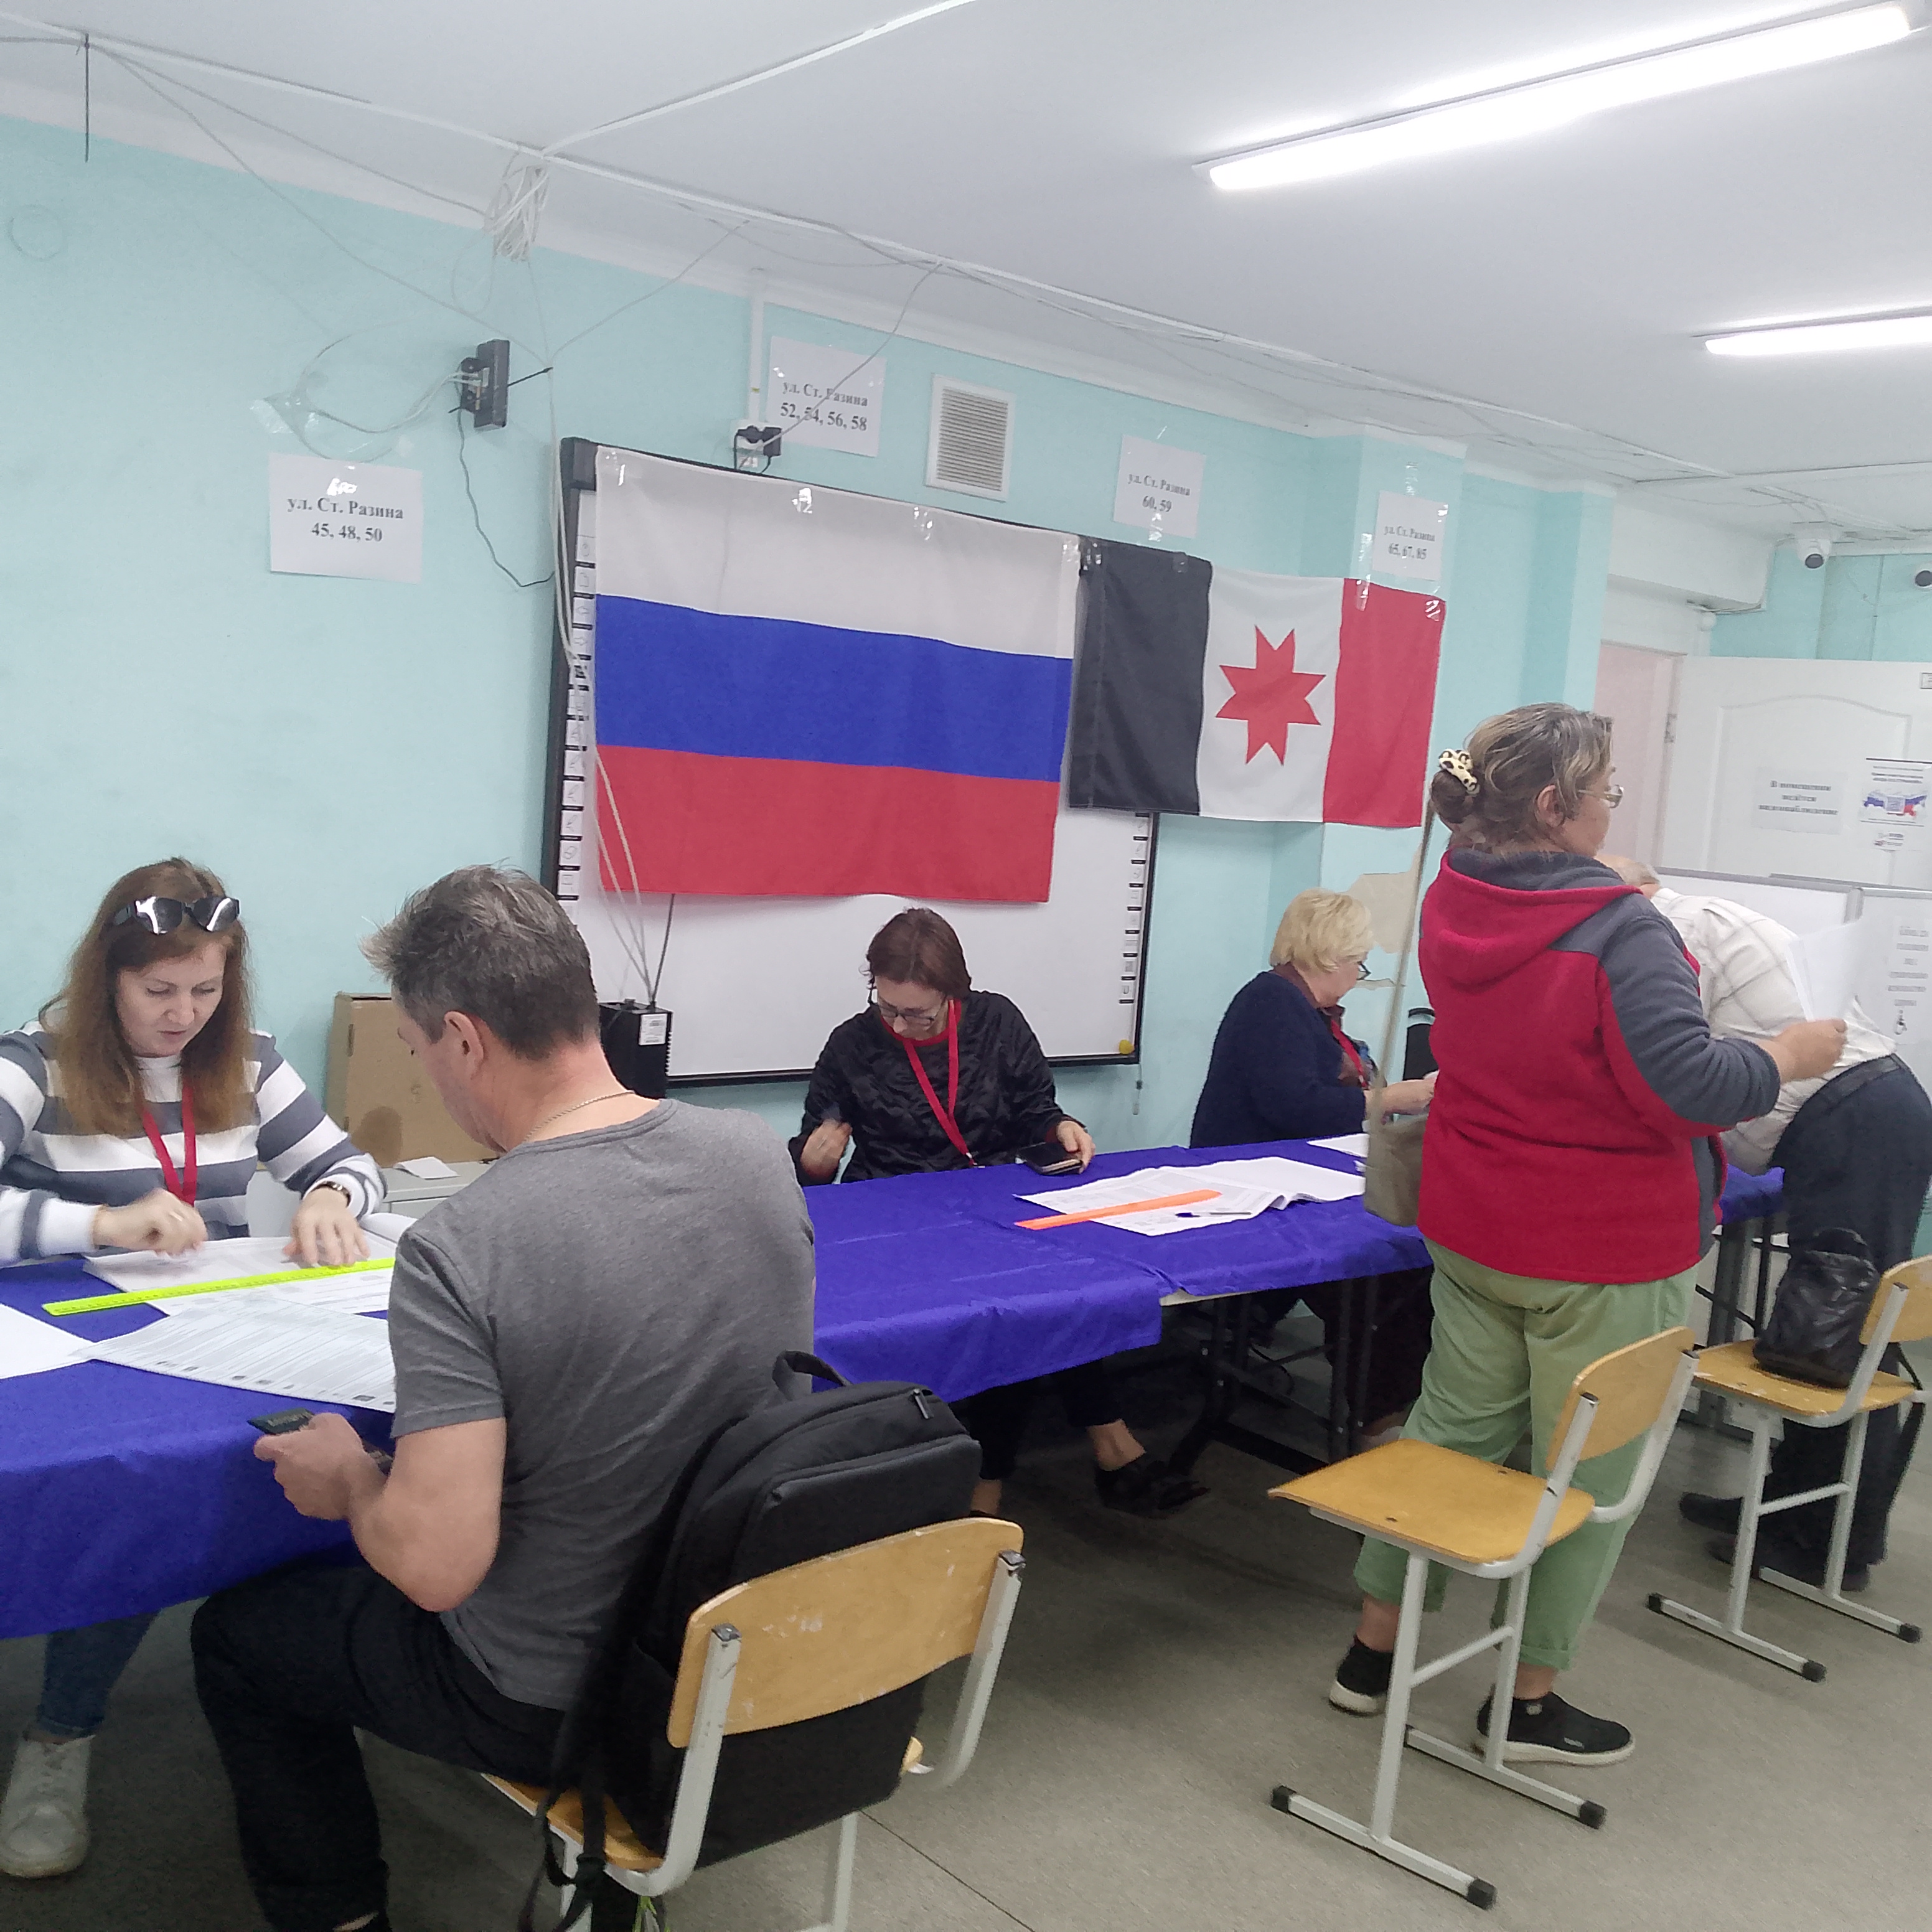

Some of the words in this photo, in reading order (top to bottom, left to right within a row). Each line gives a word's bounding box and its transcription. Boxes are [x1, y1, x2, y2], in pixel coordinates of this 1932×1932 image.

[782, 382, 800, 394] ул.
[803, 383, 822, 398] Ст.
[825, 388, 868, 406] Разина
[780, 401, 800, 420] 52,
[804, 406, 823, 425] 54,
[827, 411, 847, 429] 56,
[851, 416, 867, 431] 58
[287, 498, 312, 512] ул.
[317, 497, 344, 513] Ст.
[349, 500, 404, 519] Разина
[1159, 499, 1172, 512] 59
[311, 522, 334, 538] 45,
[338, 525, 361, 543] 48,
[365, 527, 383, 542] 50
